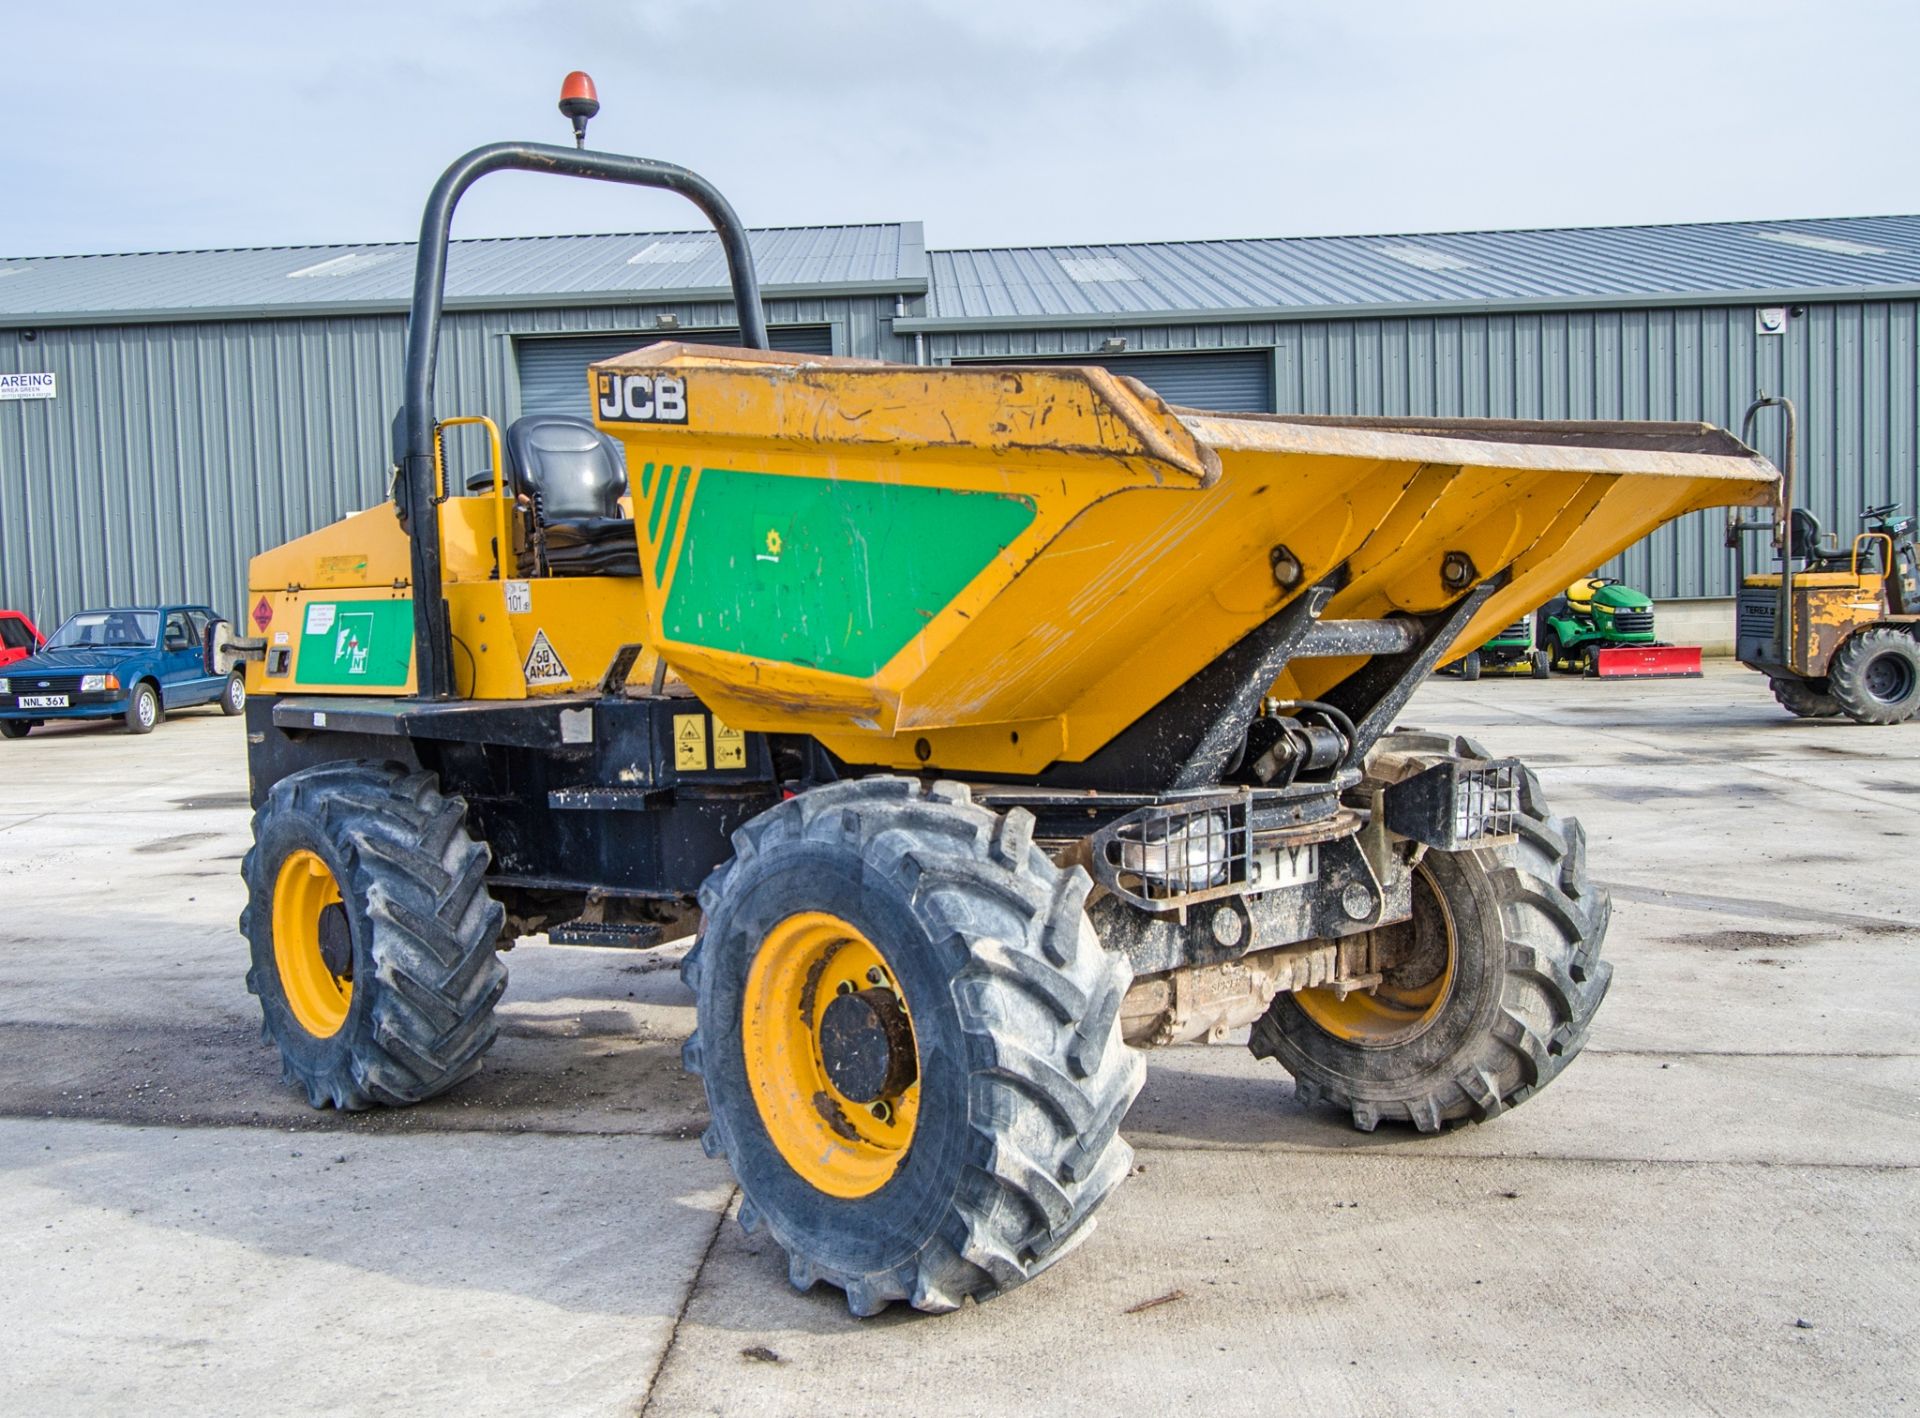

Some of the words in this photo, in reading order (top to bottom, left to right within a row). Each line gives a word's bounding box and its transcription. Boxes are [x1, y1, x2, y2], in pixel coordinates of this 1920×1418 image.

[1, 375, 53, 387] AREING
[600, 375, 687, 420] JCB
[508, 595, 521, 611] 101
[23, 698, 43, 707] NNL
[45, 696, 65, 706] 36X
